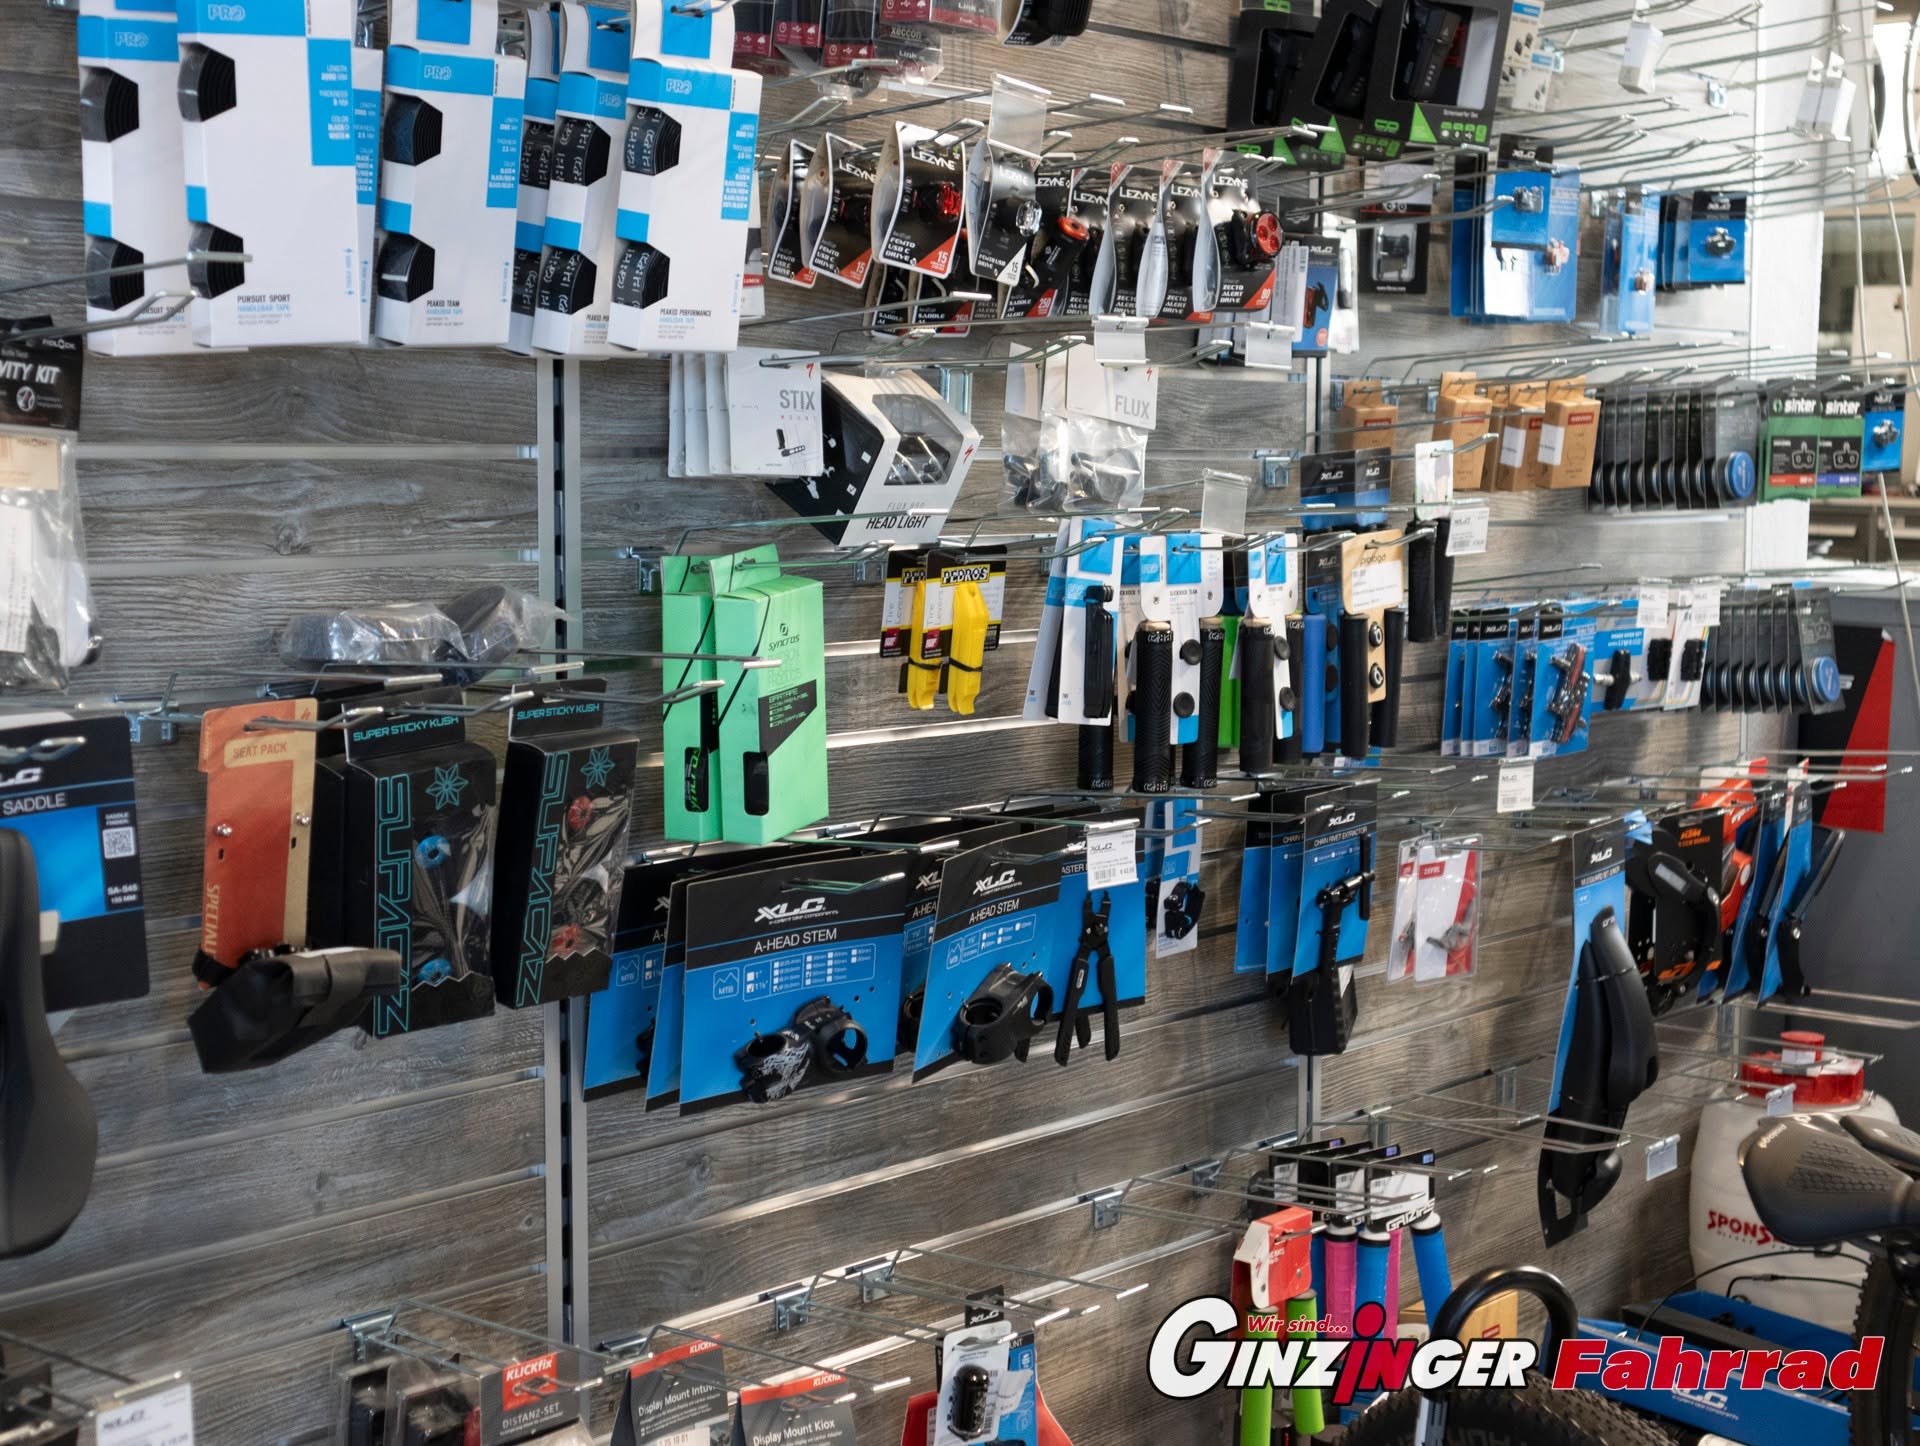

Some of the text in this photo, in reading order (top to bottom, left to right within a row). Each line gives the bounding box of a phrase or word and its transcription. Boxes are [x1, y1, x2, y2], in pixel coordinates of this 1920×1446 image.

[911, 146, 956, 171] LEZYNE
[1000, 165, 1029, 186] LEZYNE
[1212, 174, 1248, 189] LEZYNE
[1073, 190, 1109, 205] LEZYN
[1171, 183, 1202, 197] LEZYN
[819, 244, 840, 257] FEMTO
[888, 244, 904, 254] USB
[890, 236, 916, 248] FEMTO
[814, 258, 834, 270] DRIVE
[885, 250, 910, 261] DRIVE
[938, 250, 947, 264] 15
[856, 261, 865, 274] 15
[977, 260, 993, 270] DRIVE
[1011, 262, 1019, 273] 15
[238, 294, 290, 304] PURSUIT SPORT
[1167, 294, 1187, 302] ZECTO
[660, 308, 712, 318] PEAKED PERFORMANCE
[35, 364, 61, 384] KIT
[779, 389, 815, 411] STIX
[1115, 394, 1150, 420] FLUX
[1784, 398, 1817, 413] sinter
[1825, 399, 1860, 415] sinter
[866, 515, 931, 530] HEAD LIGHT
[943, 566, 989, 584] PEDRO'S
[768, 634, 800, 652] syncros
[517, 703, 600, 720] SUPER STICKY KUSH
[353, 715, 459, 742] SUPER STICKY KUSH
[233, 741, 287, 760] SEAT PACK
[2, 793, 66, 816] SADDLE
[1328, 812, 1356, 828] XLC
[1314, 826, 1368, 848] CHAIN RIVET EXTRACTOR
[1590, 847, 1613, 864] XLC
[973, 870, 1016, 895] XLC
[754, 897, 826, 923] XLC
[912, 901, 937, 918] A-HEA
[969, 899, 1020, 924] A-HEAD STEM
[753, 928, 838, 955] A-HEAD STEM
[969, 1310, 999, 1325] XLC
[506, 1359, 553, 1381] KLICKfix
[638, 1400, 664, 1417] Display
[664, 1390, 690, 1406] Mount
[502, 1402, 560, 1429] DISTANZ-SET
[753, 1416, 835, 1446] Display Mount Kiox
